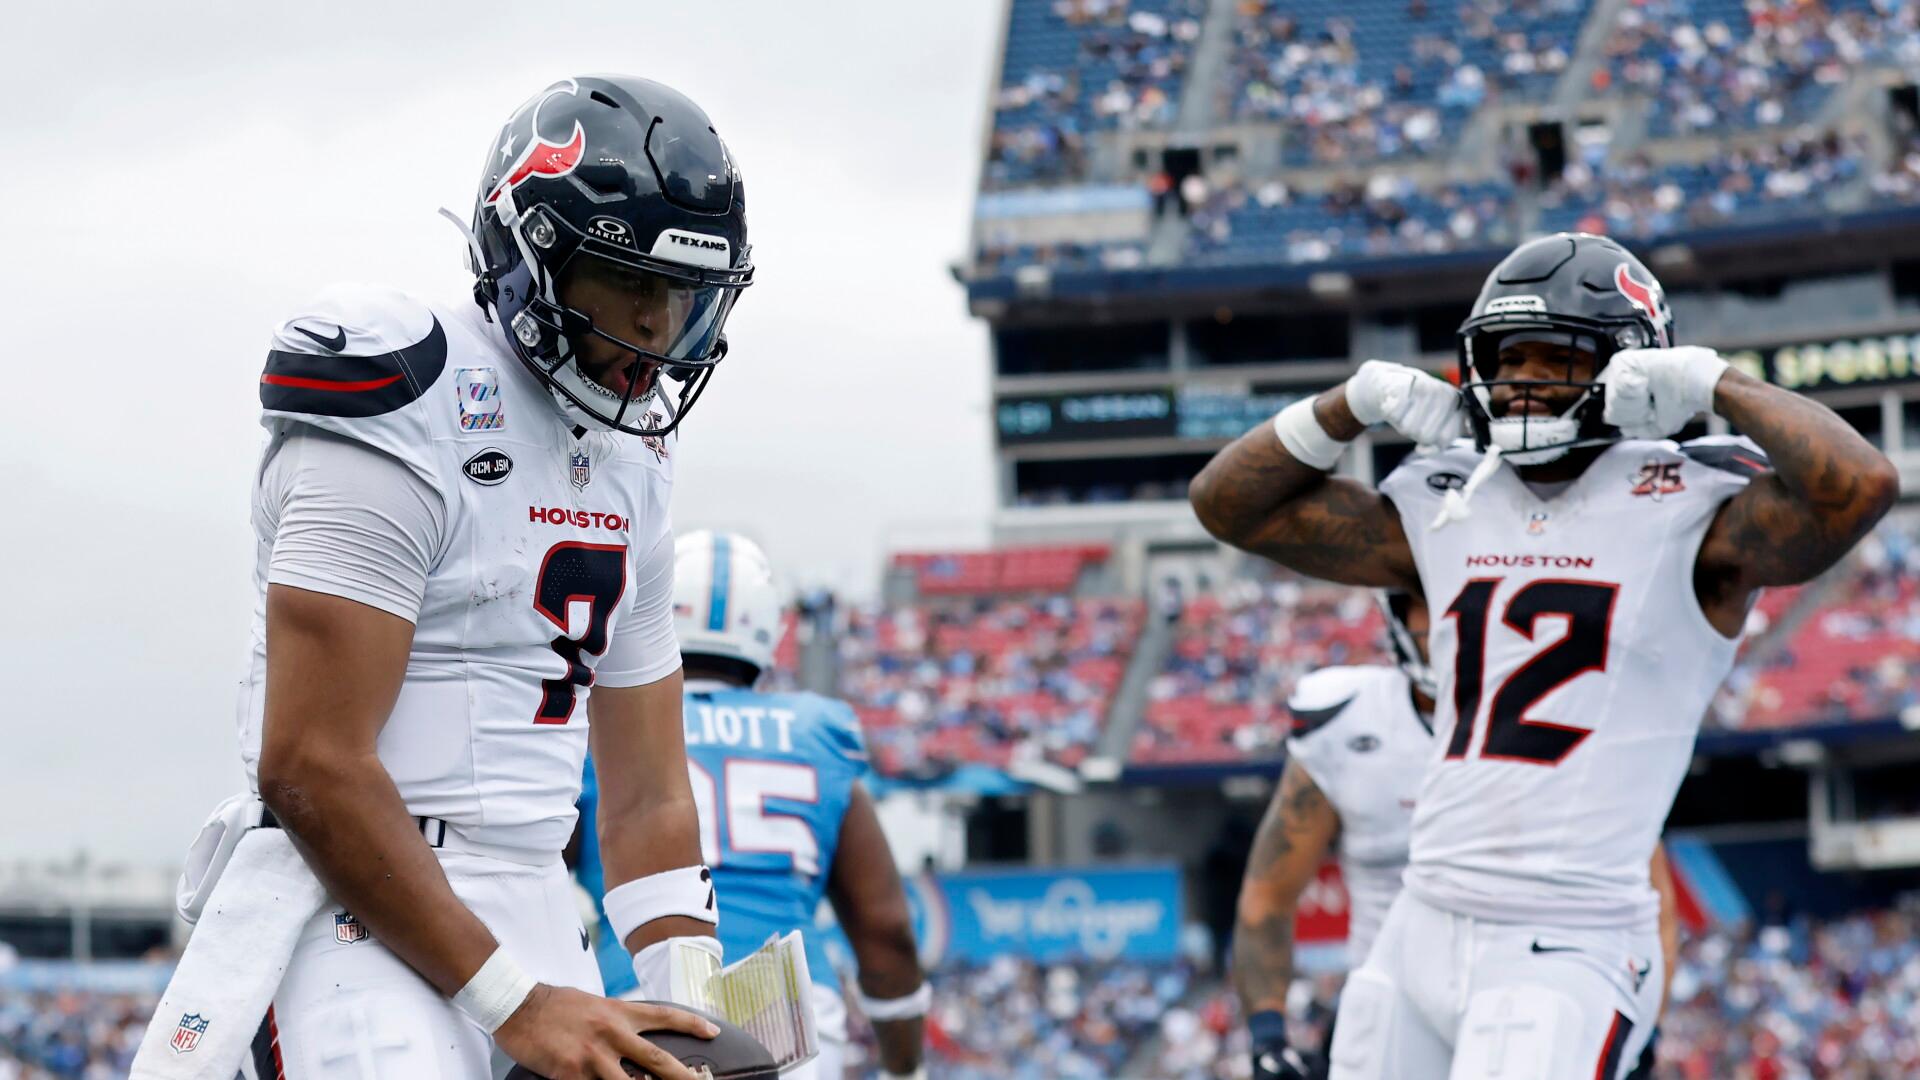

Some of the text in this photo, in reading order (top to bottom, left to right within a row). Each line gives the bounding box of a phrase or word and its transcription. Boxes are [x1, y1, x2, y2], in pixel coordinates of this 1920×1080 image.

[587, 226, 632, 246] OAKLEY
[669, 234, 728, 251] TEXANS
[1774, 334, 1920, 390] SPORT
[470, 460, 491, 475] RCM
[574, 467, 590, 483] NFL
[529, 505, 630, 534] HOUSTON
[1465, 555, 1595, 570] HOUSTON
[1442, 576, 1622, 767] 12
[338, 924, 363, 940] NFL
[173, 1028, 198, 1050] NFL
